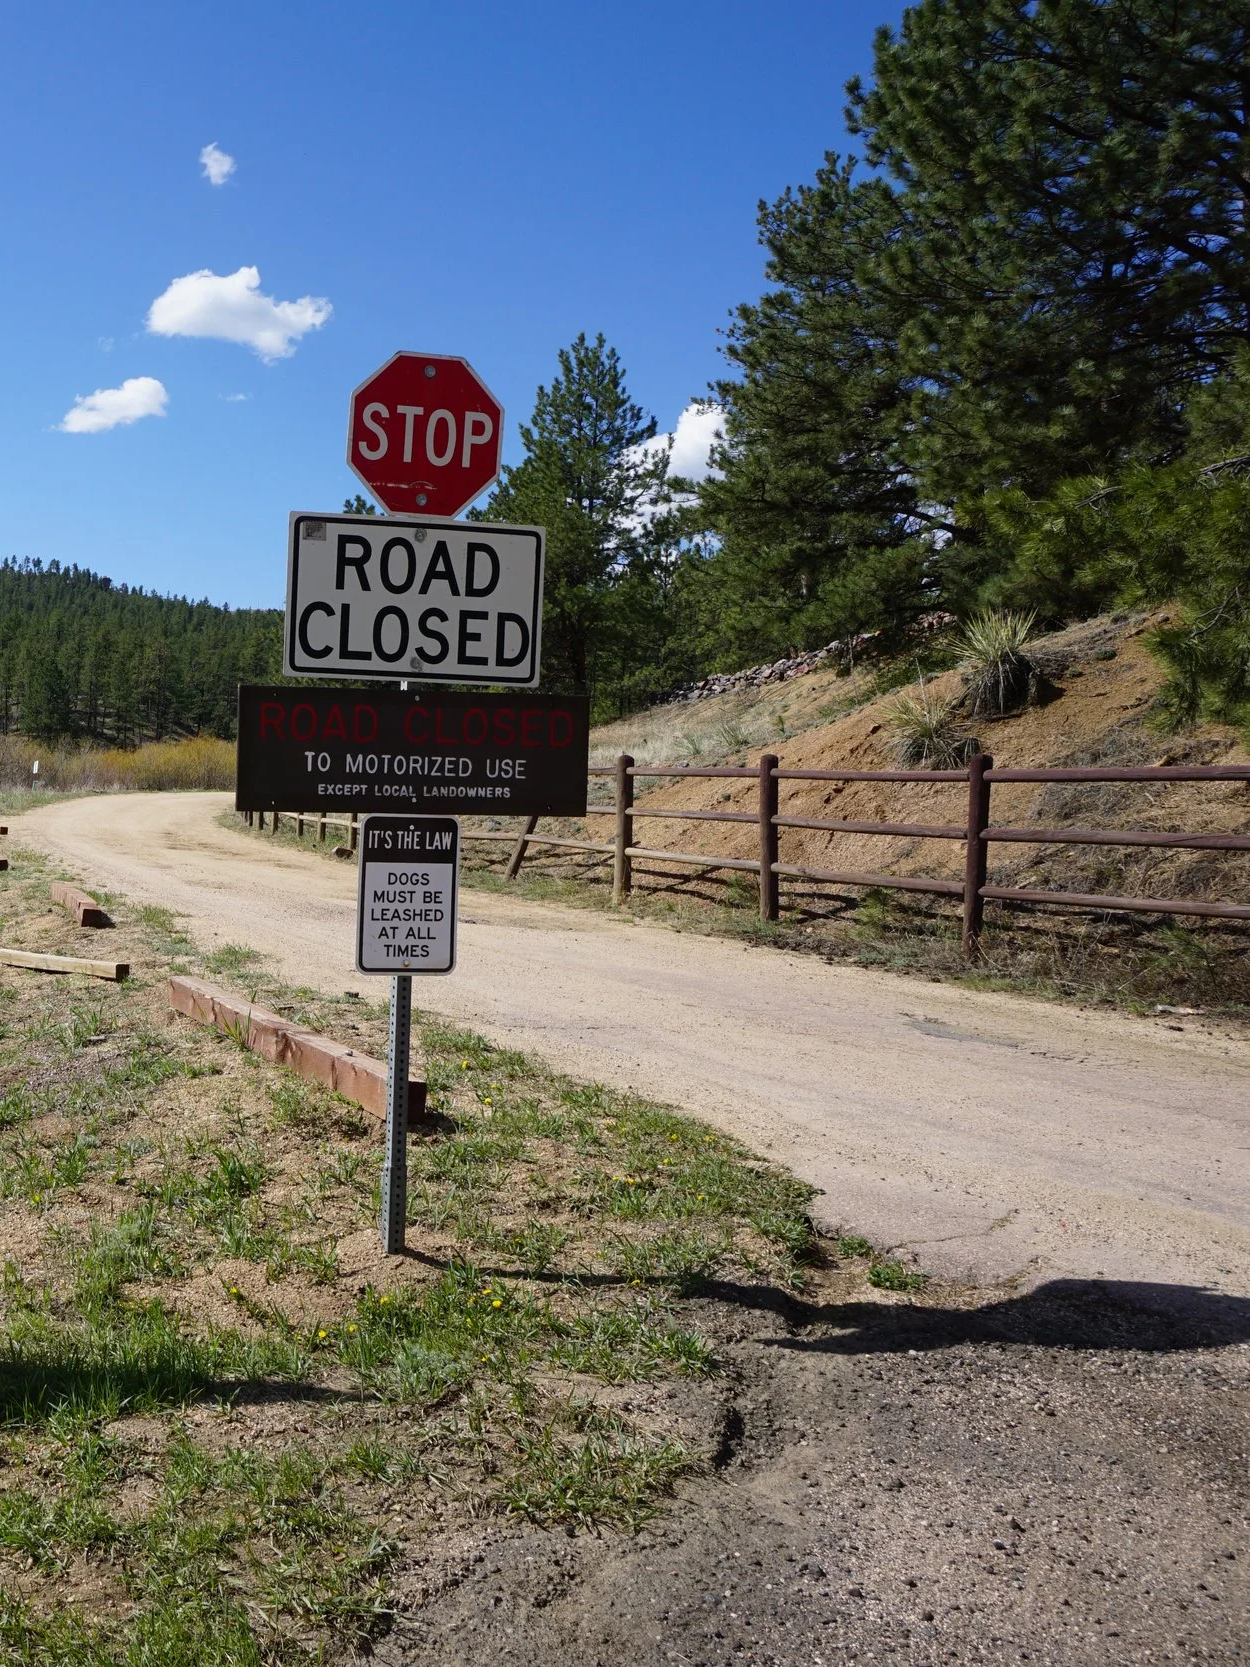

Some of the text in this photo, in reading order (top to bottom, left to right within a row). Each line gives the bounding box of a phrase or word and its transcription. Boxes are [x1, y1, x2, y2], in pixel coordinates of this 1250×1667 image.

[359, 402, 493, 467] STOP
[335, 534, 500, 598] ROAD
[299, 601, 530, 667] CLOSED
[260, 703, 573, 747] ROAD CLOSED
[305, 751, 526, 779] TO MOTORIZED USE
[318, 784, 510, 798] EXCEPT LOCAL LANDOWNERS
[368, 830, 452, 850] IT'S THE LAW
[388, 873, 430, 885] DOGS
[373, 891, 442, 904] MUST BE
[371, 909, 444, 921] LEASHED
[378, 927, 436, 940] AT ALL
[384, 945, 429, 957] TIMES
